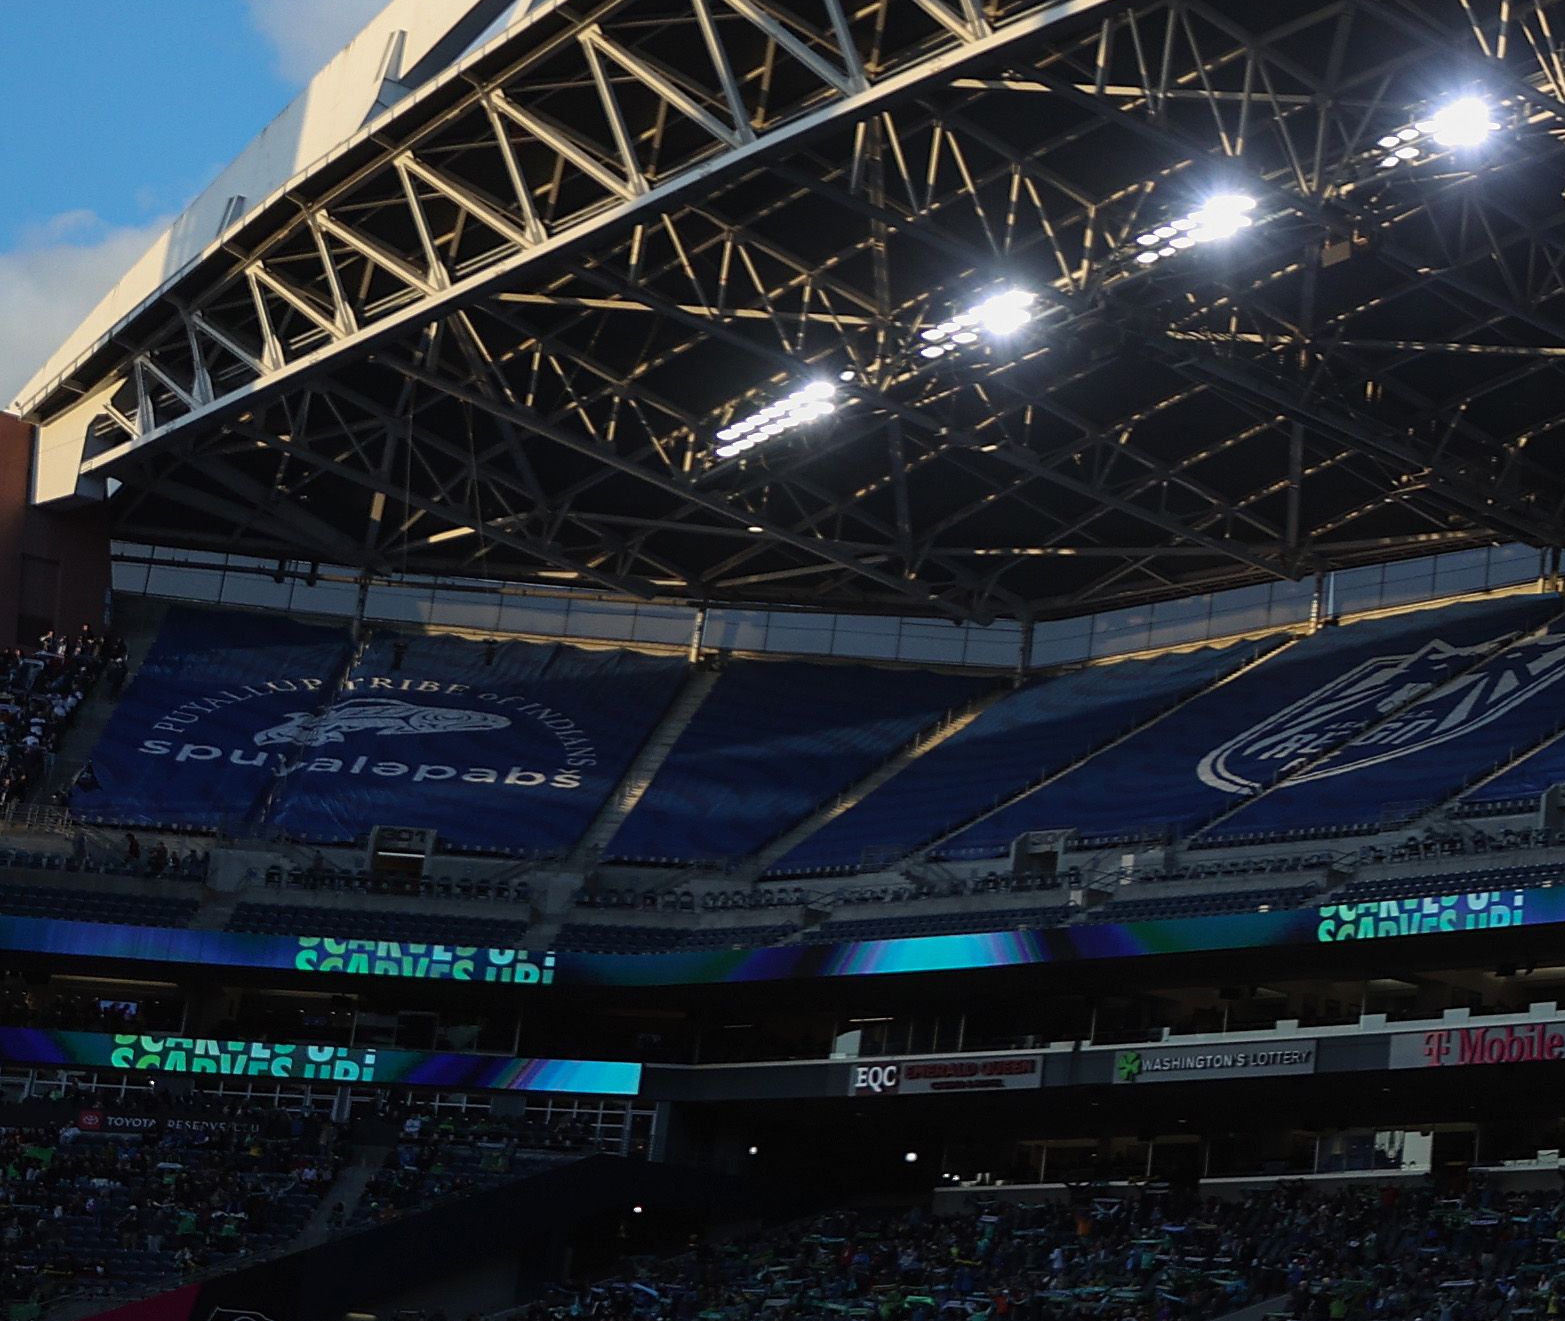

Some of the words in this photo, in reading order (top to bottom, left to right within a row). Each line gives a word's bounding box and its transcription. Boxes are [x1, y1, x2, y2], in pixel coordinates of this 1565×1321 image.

[152, 677, 323, 734] PUYALLUP
[477, 689, 515, 705] of
[517, 696, 598, 770] INDIANS
[1458, 1024, 1565, 1066] Mobile
[1141, 1054, 1246, 1071] WASHINGTON'S
[1250, 1051, 1312, 1066] LOTTERY
[855, 1065, 898, 1092] EQC
[106, 1116, 157, 1129] TOYOTA
